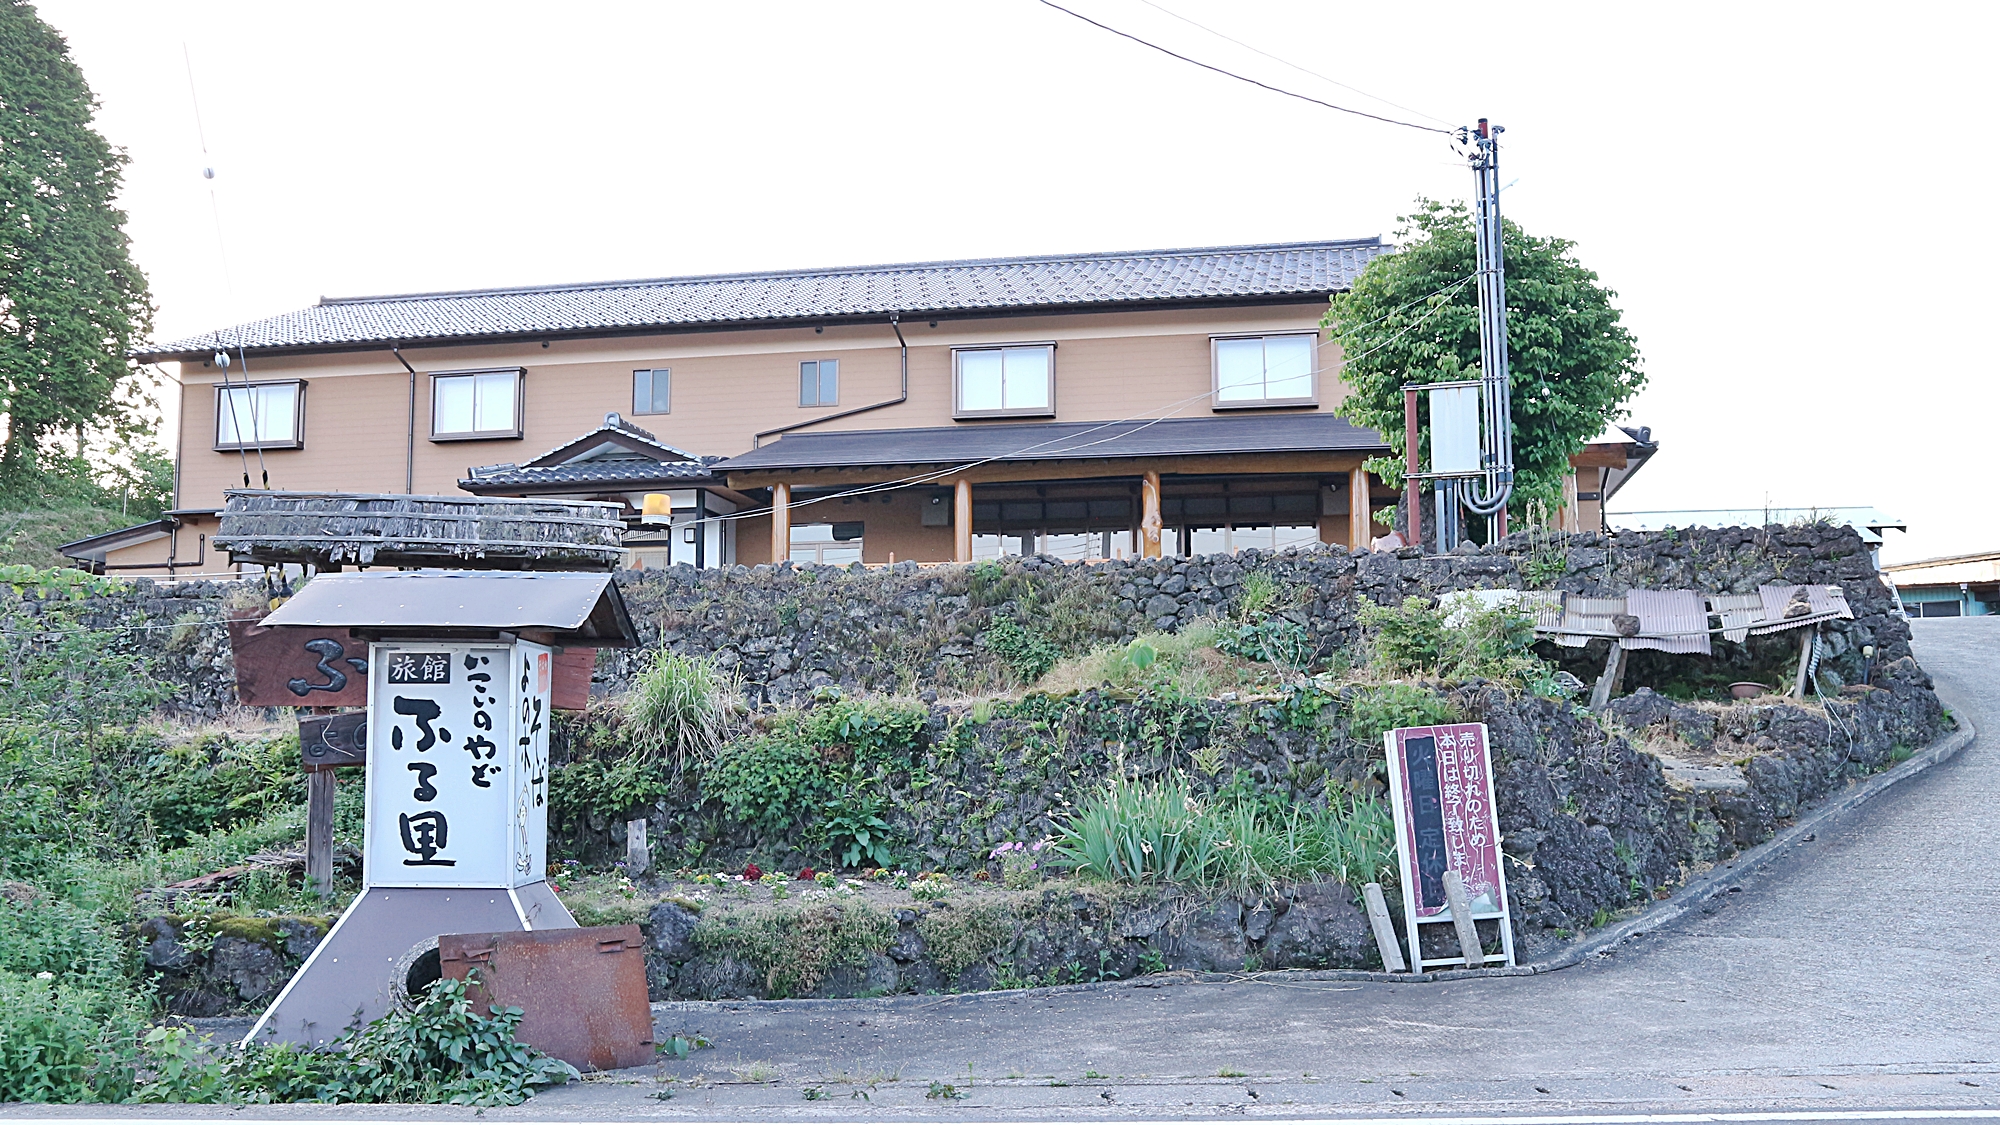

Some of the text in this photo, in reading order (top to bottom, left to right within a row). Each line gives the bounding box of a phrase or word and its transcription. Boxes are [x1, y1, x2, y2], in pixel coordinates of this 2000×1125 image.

[391, 655, 449, 682] 旅館
[463, 654, 501, 788] いこいのやど
[391, 695, 456, 867] ふる里
[530, 695, 547, 810] そば
[1438, 733, 1468, 882] 本日は終了致しま
[1459, 731, 1486, 848] 売り切れのため
